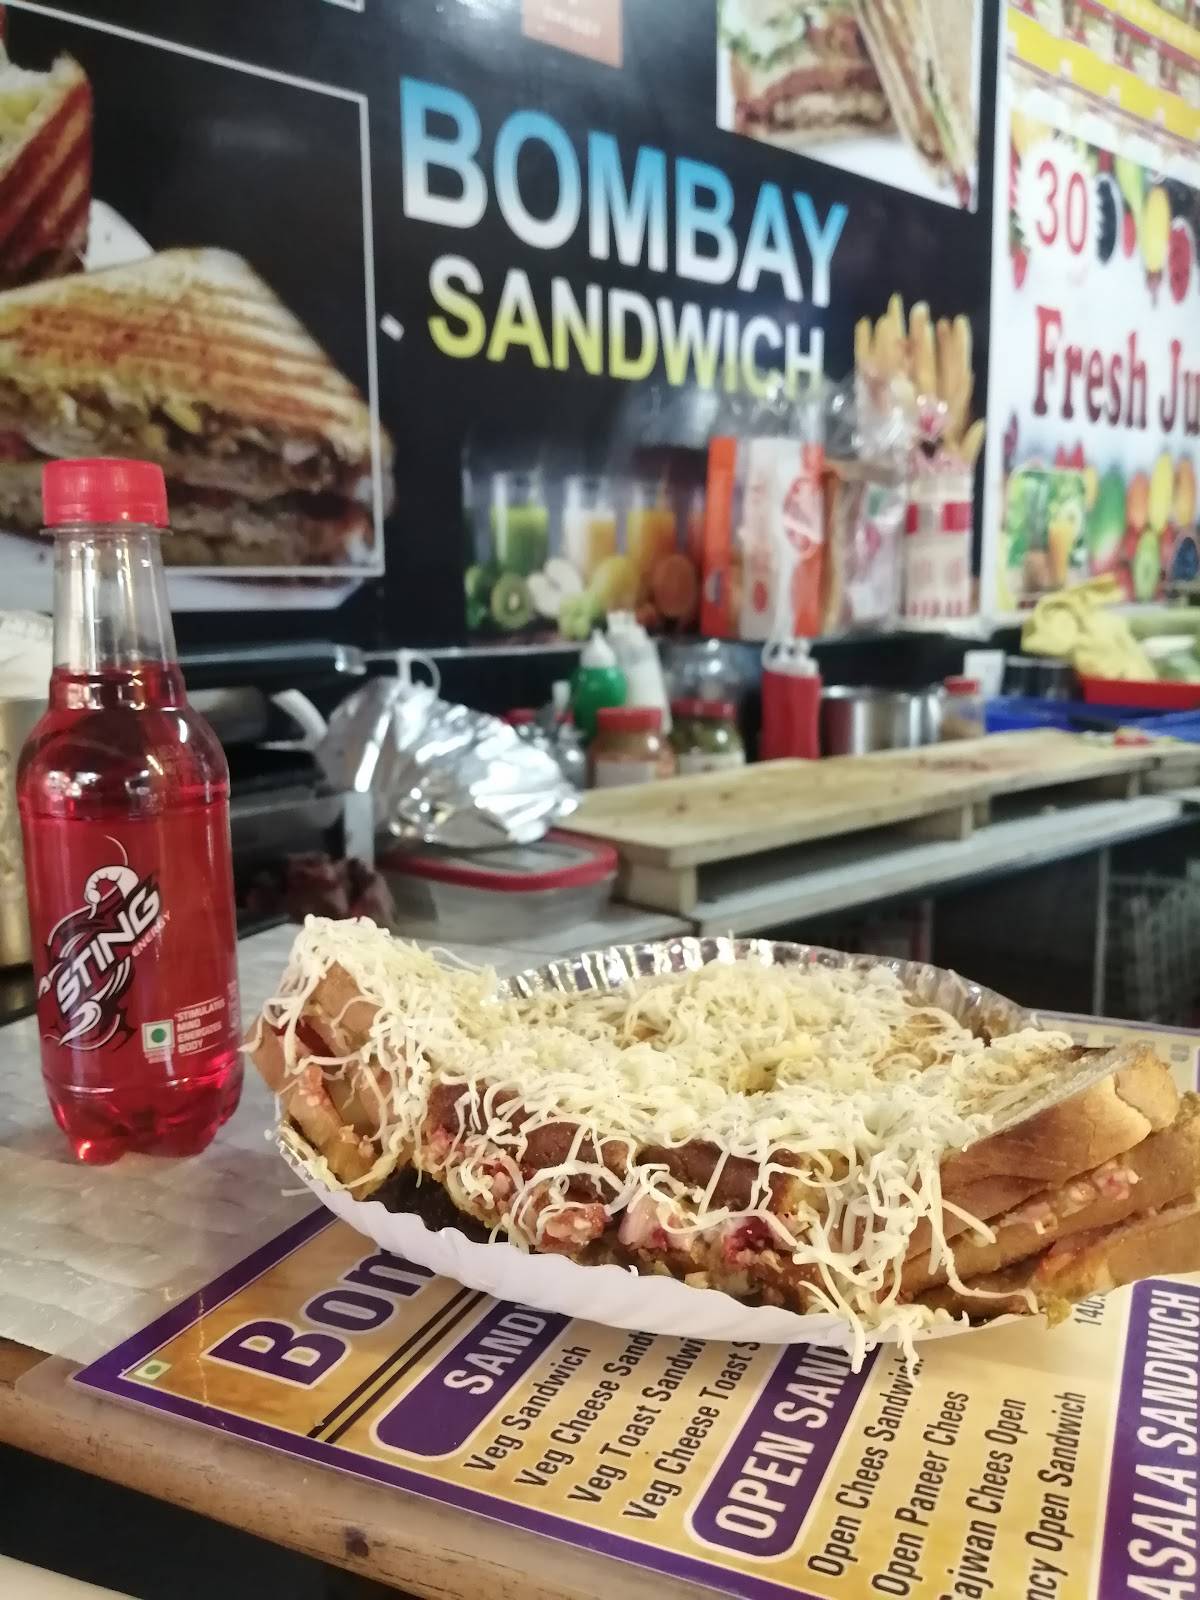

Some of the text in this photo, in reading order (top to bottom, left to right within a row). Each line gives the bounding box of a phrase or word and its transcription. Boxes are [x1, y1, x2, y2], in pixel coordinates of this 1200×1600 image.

[401, 74, 849, 308] BOMBAY
[1035, 159, 1089, 255] 30
[428, 254, 825, 398] SANDWICH
[1033, 304, 1147, 430] Fresh
[56, 886, 160, 1013] STING
[443, 1304, 557, 1395] SAND
[464, 1345, 592, 1473] Veg Sandwich
[1136, 1289, 1200, 1454] SANDWICH
[514, 1449, 574, 1489] Veg
[551, 1379, 620, 1446] Cheese
[568, 1463, 627, 1504] Veg
[600, 1404, 662, 1460] Toast
[623, 1477, 683, 1521] Veg
[655, 1406, 720, 1475] Cheese
[699, 1353, 752, 1400] Toast
[715, 1431, 815, 1539] OPEN
[871, 1391, 969, 1596] Open Paneer Chees
[1038, 1392, 1086, 1487] Sandwich
[807, 1515, 862, 1576] Open
[835, 1446, 888, 1509] Chees
[939, 1398, 1028, 1600] ajwan Chees Open
[1025, 1492, 1075, 1551] Open
